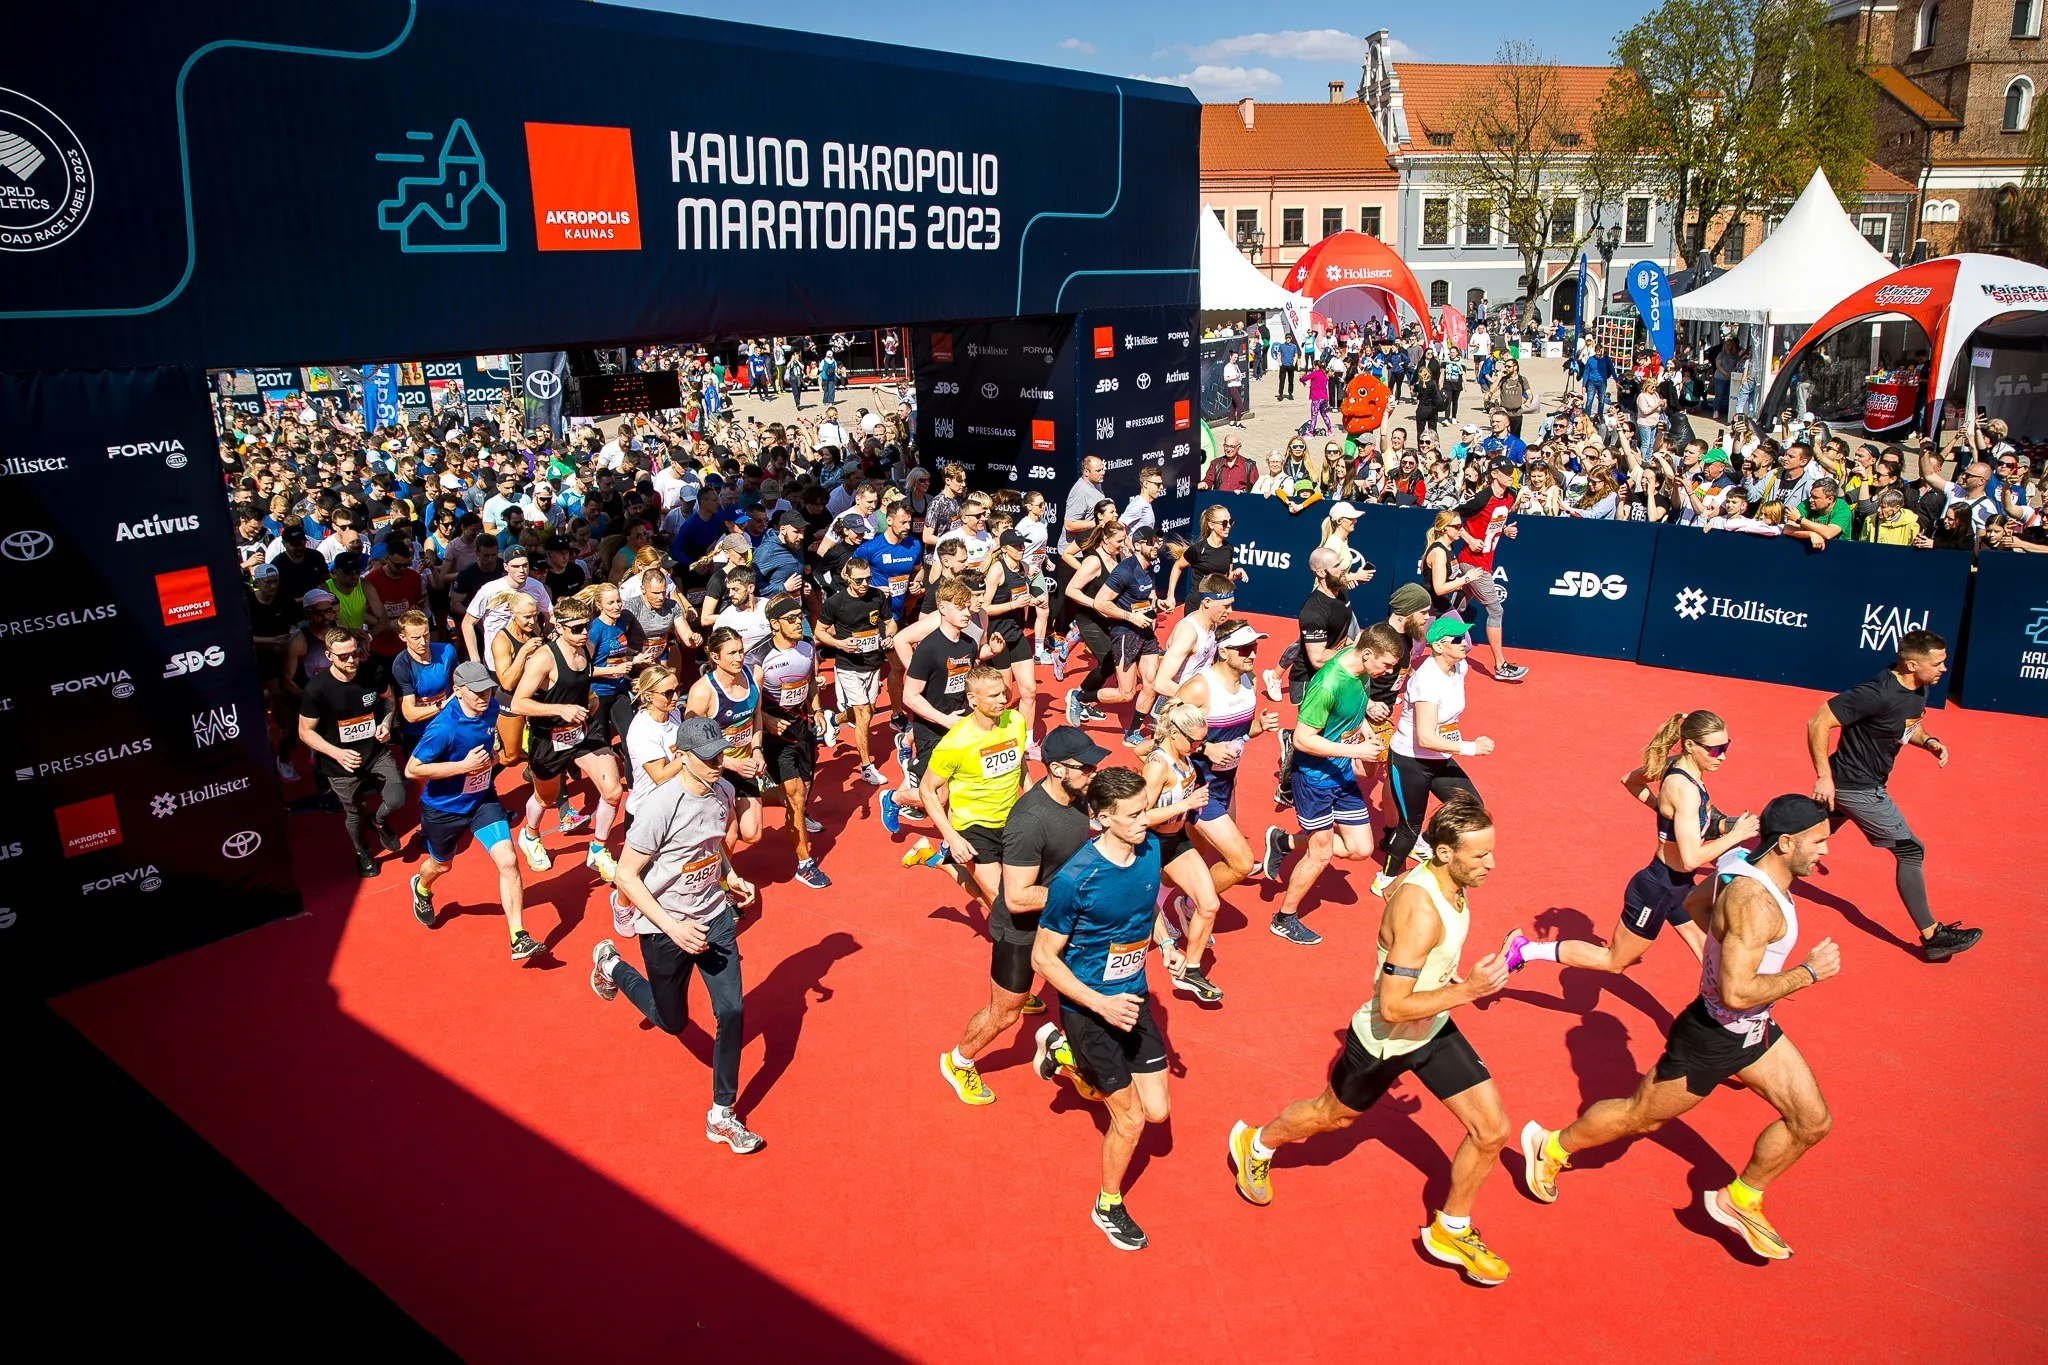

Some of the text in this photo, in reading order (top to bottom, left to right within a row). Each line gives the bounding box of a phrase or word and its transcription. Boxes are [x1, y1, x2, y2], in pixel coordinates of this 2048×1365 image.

[67, 149, 86, 183] 2023
[670, 130, 998, 196] KAUNO AKROPOLIO
[63, 186, 87, 223] LABEL
[546, 211, 631, 225] AKROPOLIS
[677, 198, 1000, 250] MARATONAS 2023
[34, 219, 69, 243] RACE
[564, 229, 614, 239] KAUNAS
[256, 372, 292, 387] 2017
[425, 363, 462, 377] 2021
[1166, 370, 1190, 384] Activus
[467, 388, 502, 402] 2022
[934, 381, 960, 395] SDG
[1020, 386, 1054, 400] Activus
[1095, 378, 1119, 394] SDG
[1131, 415, 1164, 428] PRESSGLASS
[975, 426, 1017, 437] PRESSGLASS
[107, 439, 185, 459] FORVIA
[1028, 465, 1056, 480] SDG
[116, 514, 200, 541] Activus
[1549, 571, 1628, 600] SDG
[168, 600, 210, 615] AKROPOLIS
[177, 609, 203, 619] KAUNAS
[0, 604, 117, 637] PRESSGLASS
[163, 646, 225, 679] SDG
[51, 669, 132, 696] FORVIA
[344, 721, 372, 736] 2407
[39, 738, 152, 777] PRESSGLASS
[985, 750, 1017, 769] 2709
[69, 828, 117, 847] AKROPOLIS
[80, 838, 108, 850] KAUNAS
[82, 864, 159, 895] FORVIA
[685, 864, 716, 886] 2482
[1111, 946, 1147, 969] 2069
